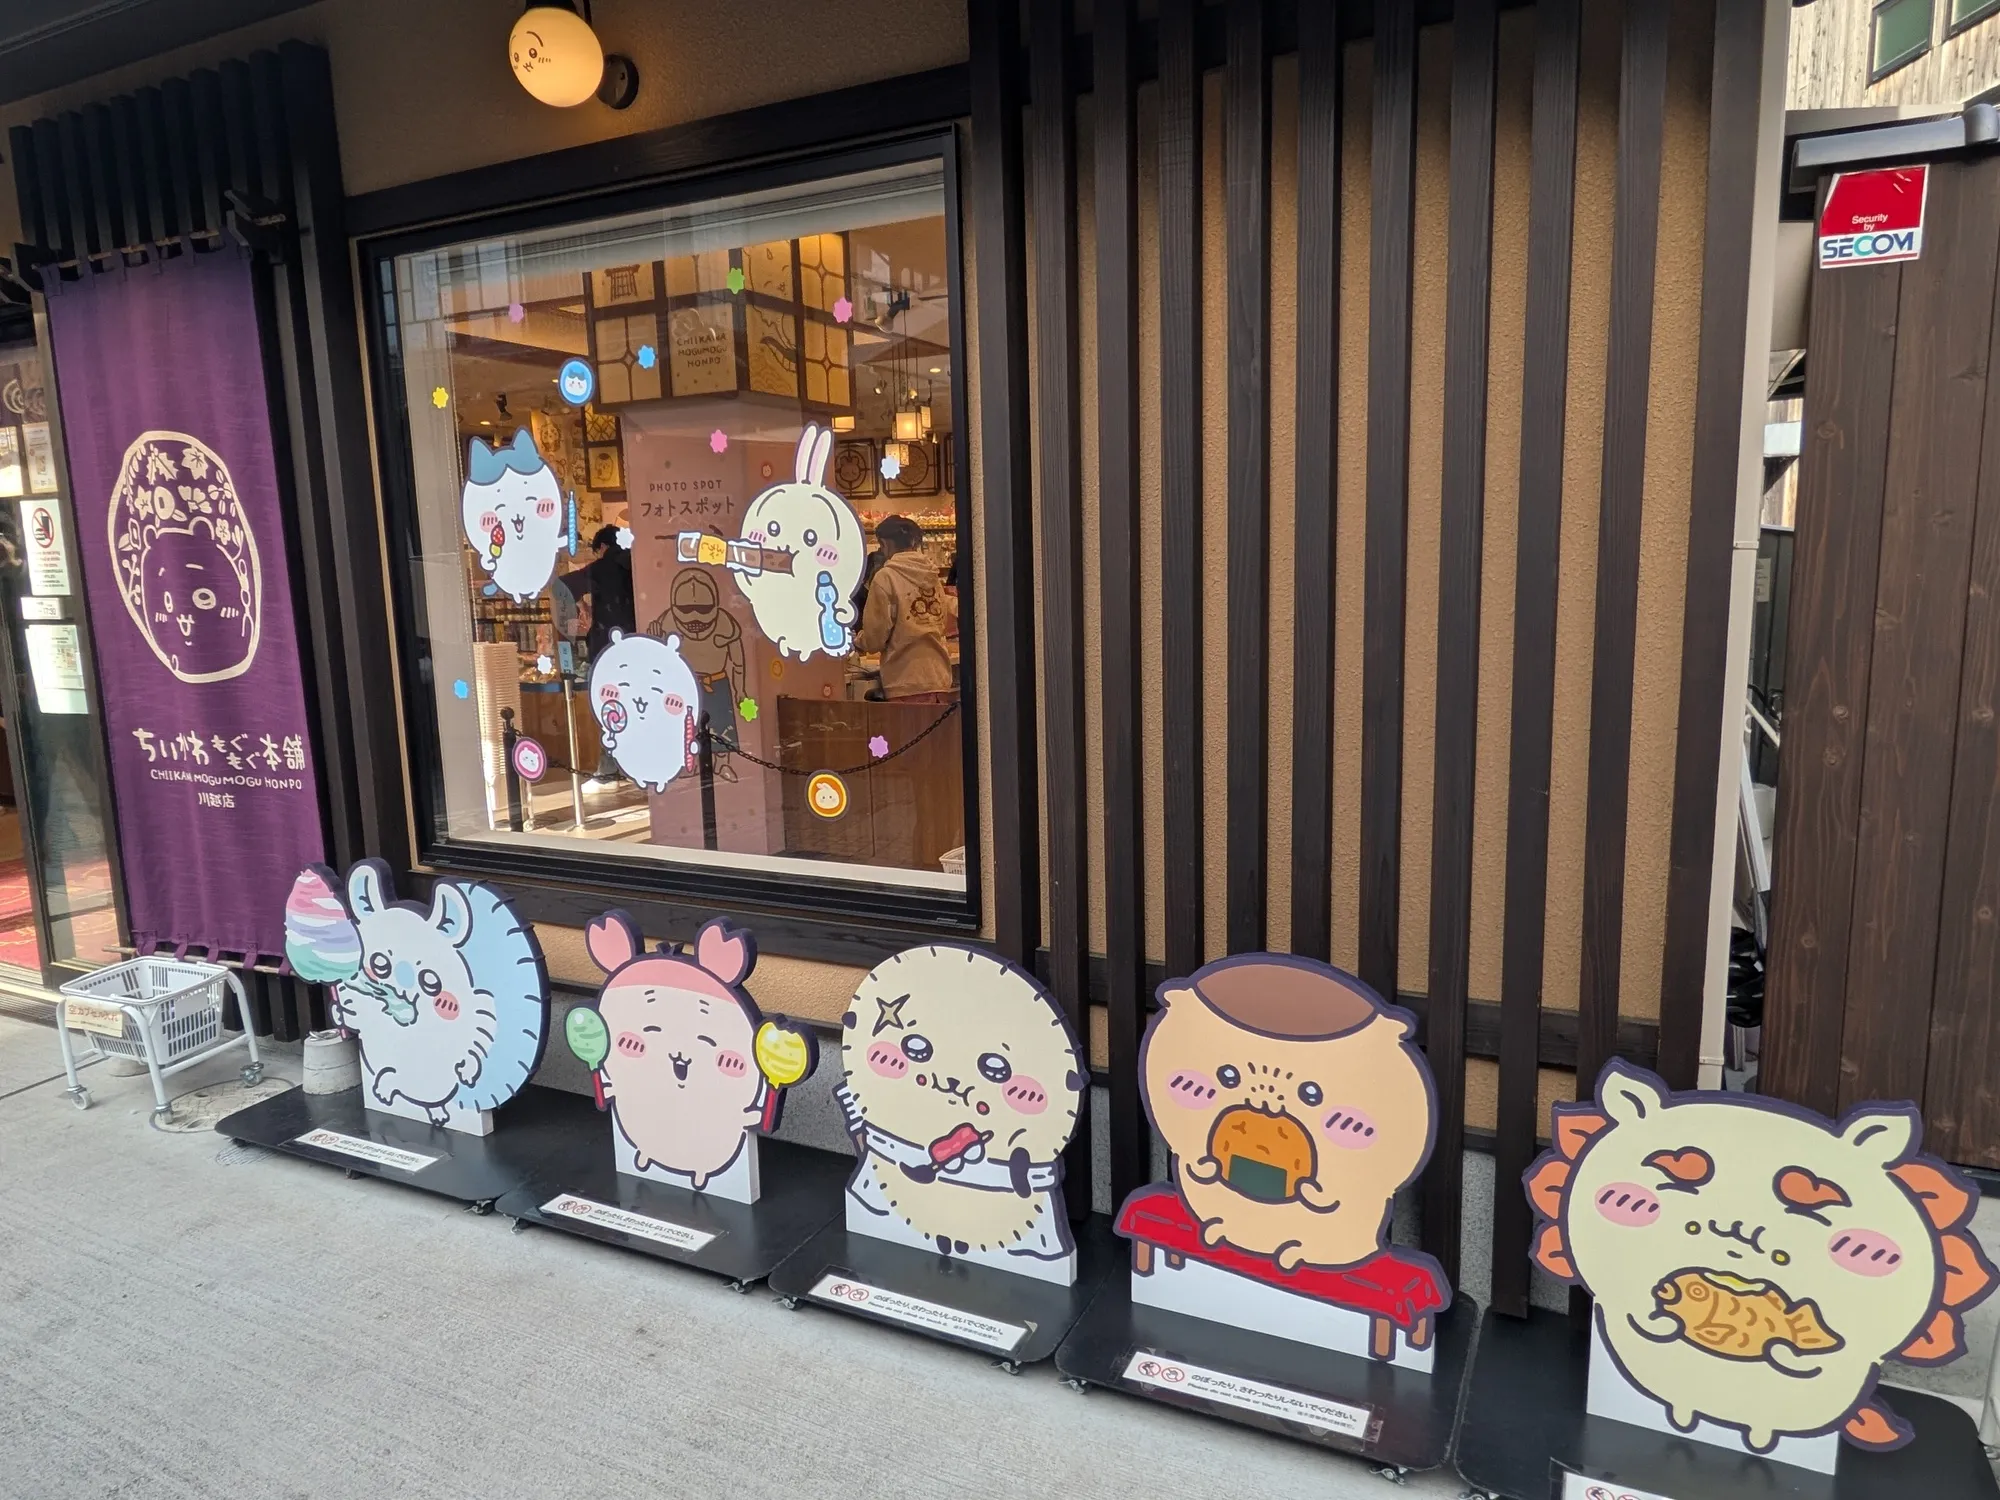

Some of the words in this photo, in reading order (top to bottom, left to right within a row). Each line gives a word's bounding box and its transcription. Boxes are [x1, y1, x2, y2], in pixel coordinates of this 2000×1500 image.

[1852, 213, 1888, 224] Security
[1863, 223, 1875, 231] by
[1823, 231, 1914, 259] SECOM
[687, 357, 721, 368] HONPO
[650, 481, 687, 492] PHOTO
[693, 479, 722, 490] SPOT
[641, 496, 734, 517] フォトスポット
[265, 777, 302, 790] HONPO
[198, 792, 236, 808] 川越店
[1191, 1374, 1357, 1422] のぼったり、さわったりしないでください。
